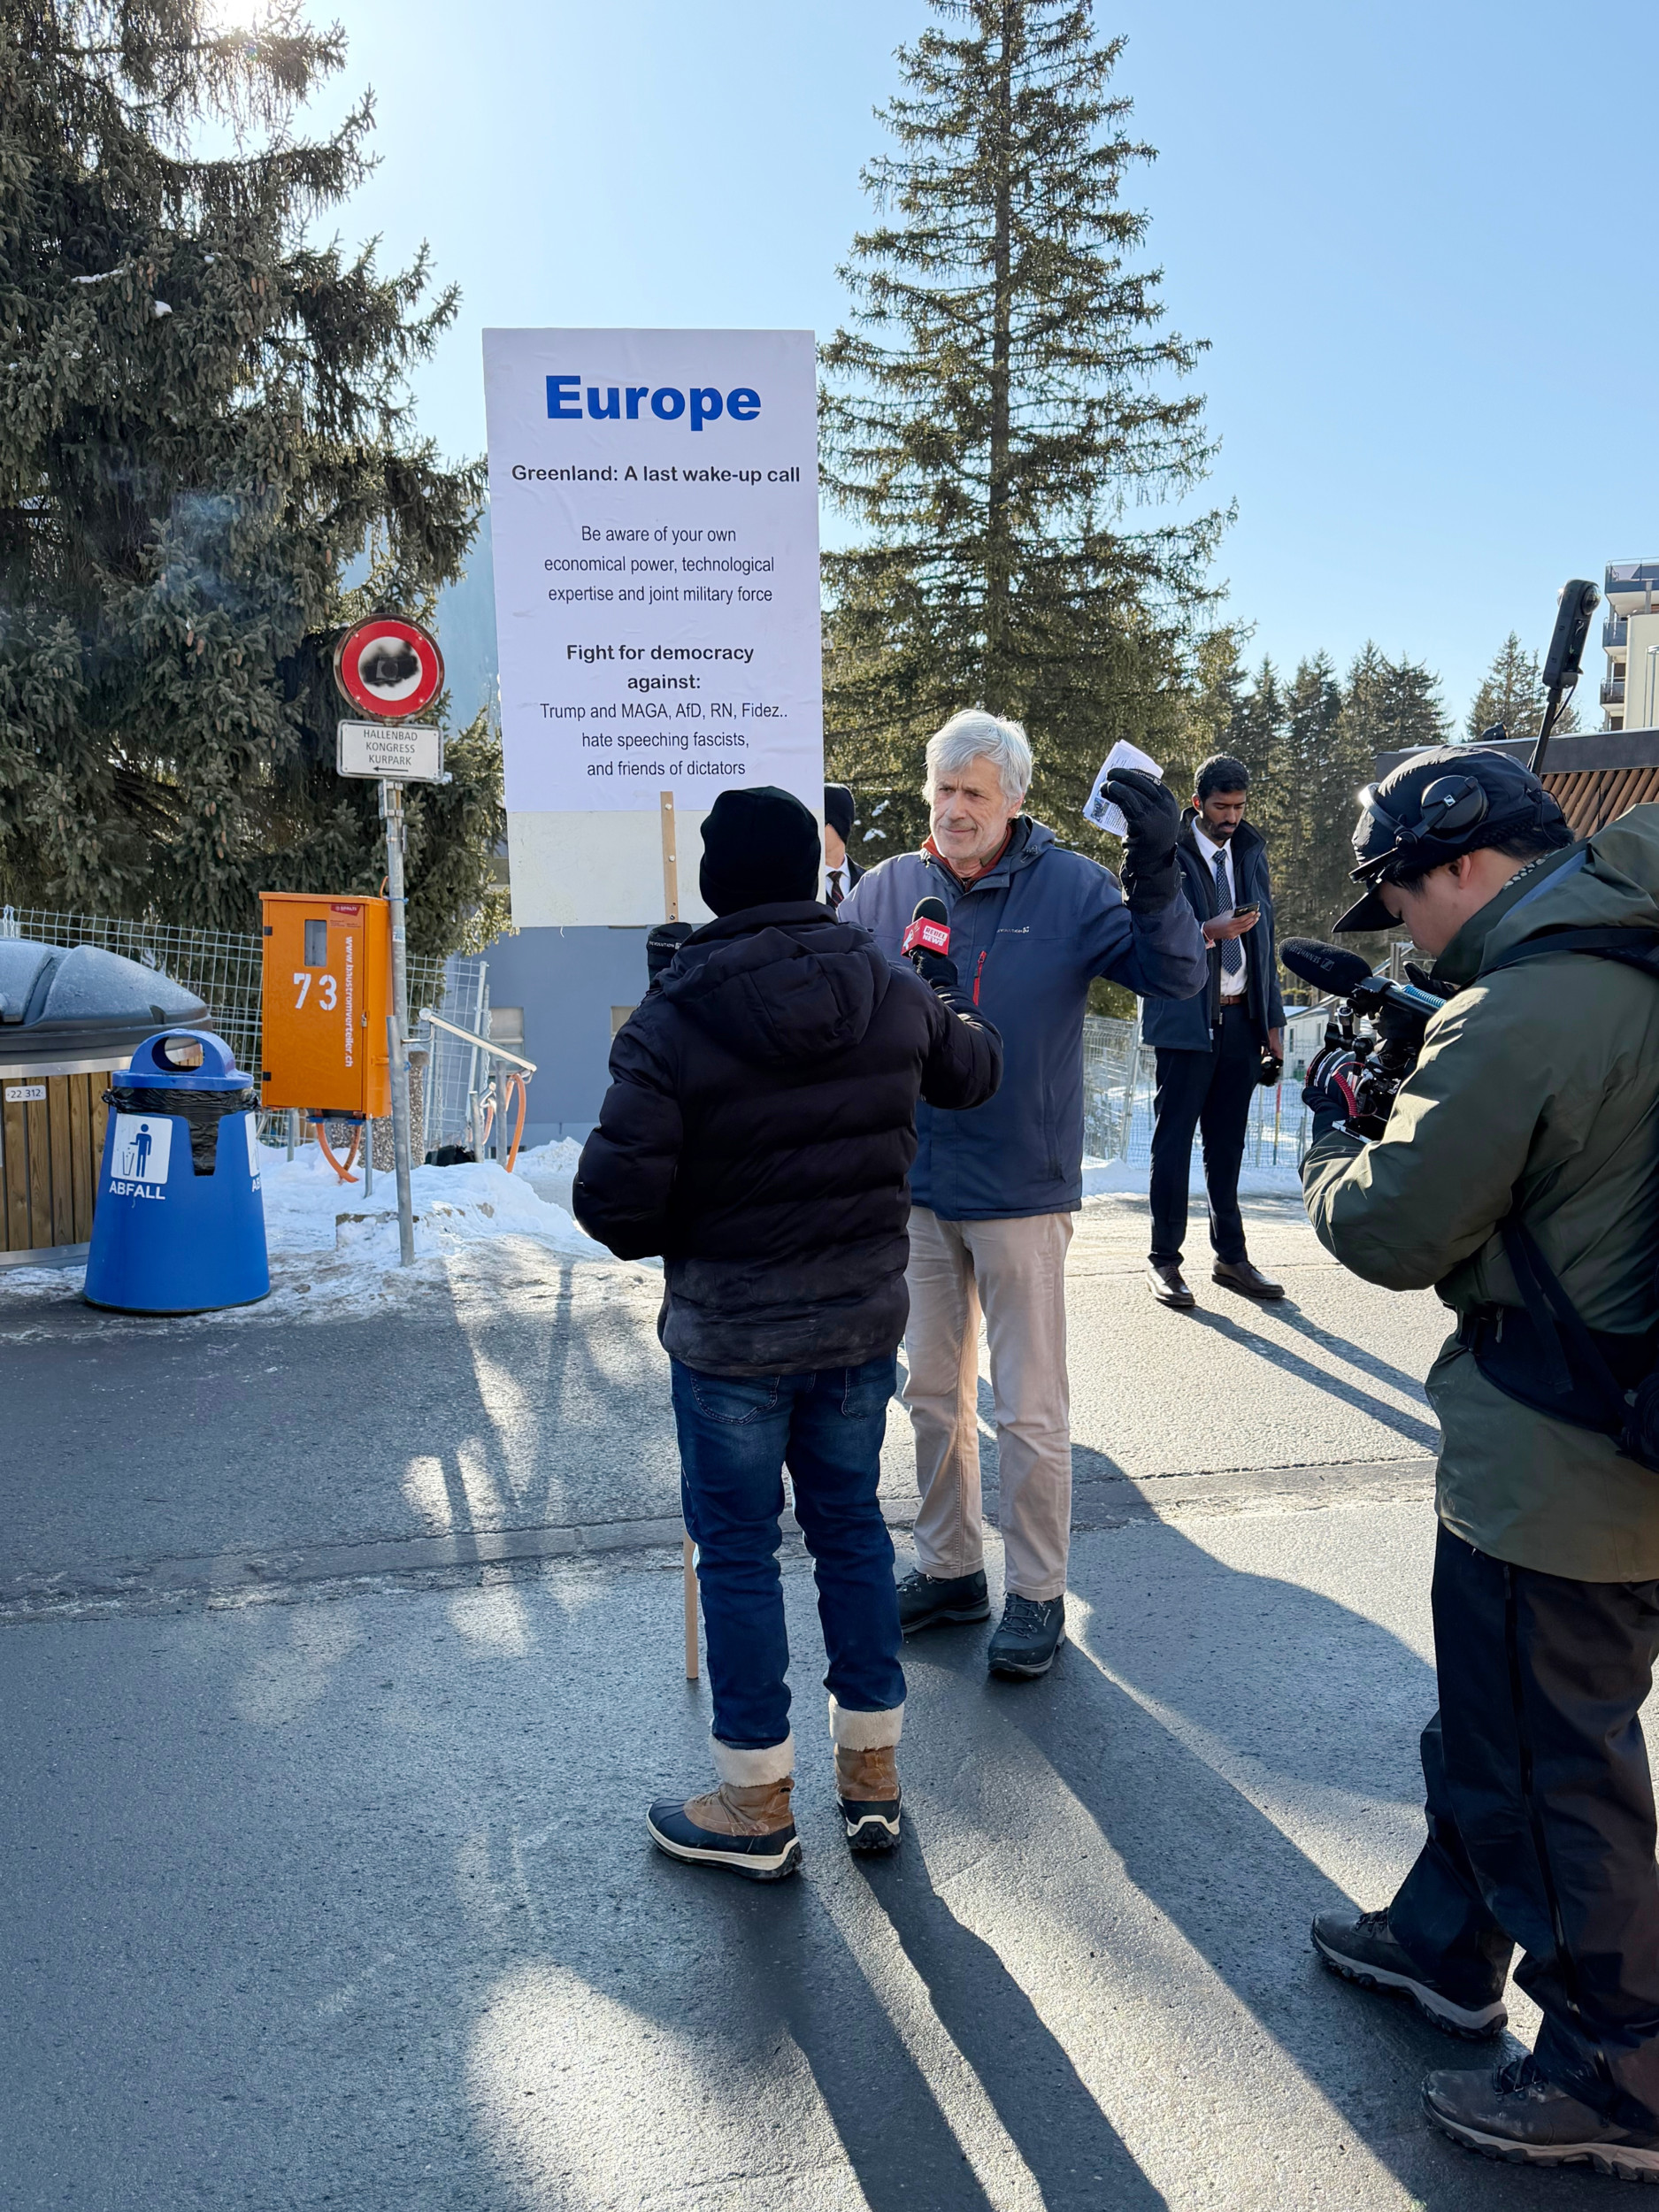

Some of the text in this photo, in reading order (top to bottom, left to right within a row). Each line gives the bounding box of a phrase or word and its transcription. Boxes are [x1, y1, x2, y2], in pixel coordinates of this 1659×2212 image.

[546, 375, 762, 432] Europe
[511, 465, 800, 486] Greenland: A last wake-up call
[581, 526, 736, 545] Be aware of your own
[544, 556, 774, 576] economical power, technological
[548, 586, 772, 605] expertise and joint military force
[566, 644, 755, 663] Fight for democracy
[627, 674, 701, 694] against:
[540, 702, 788, 722] Trump and MAGA, AfD, RN, Fidez..
[364, 729, 419, 741] HALLENBAD
[581, 731, 750, 751] hate speeching fascists,
[365, 741, 416, 753] KONGRESS
[368, 754, 412, 766] KURPARK
[587, 760, 746, 776] and friends of dictators
[922, 934, 945, 947] NEWS
[925, 926, 947, 940] REBEL
[345, 936, 354, 1068] www.baustromverteiler.ch
[11, 1088, 42, 1099] 22 312
[109, 1180, 165, 1201] ABFALL
